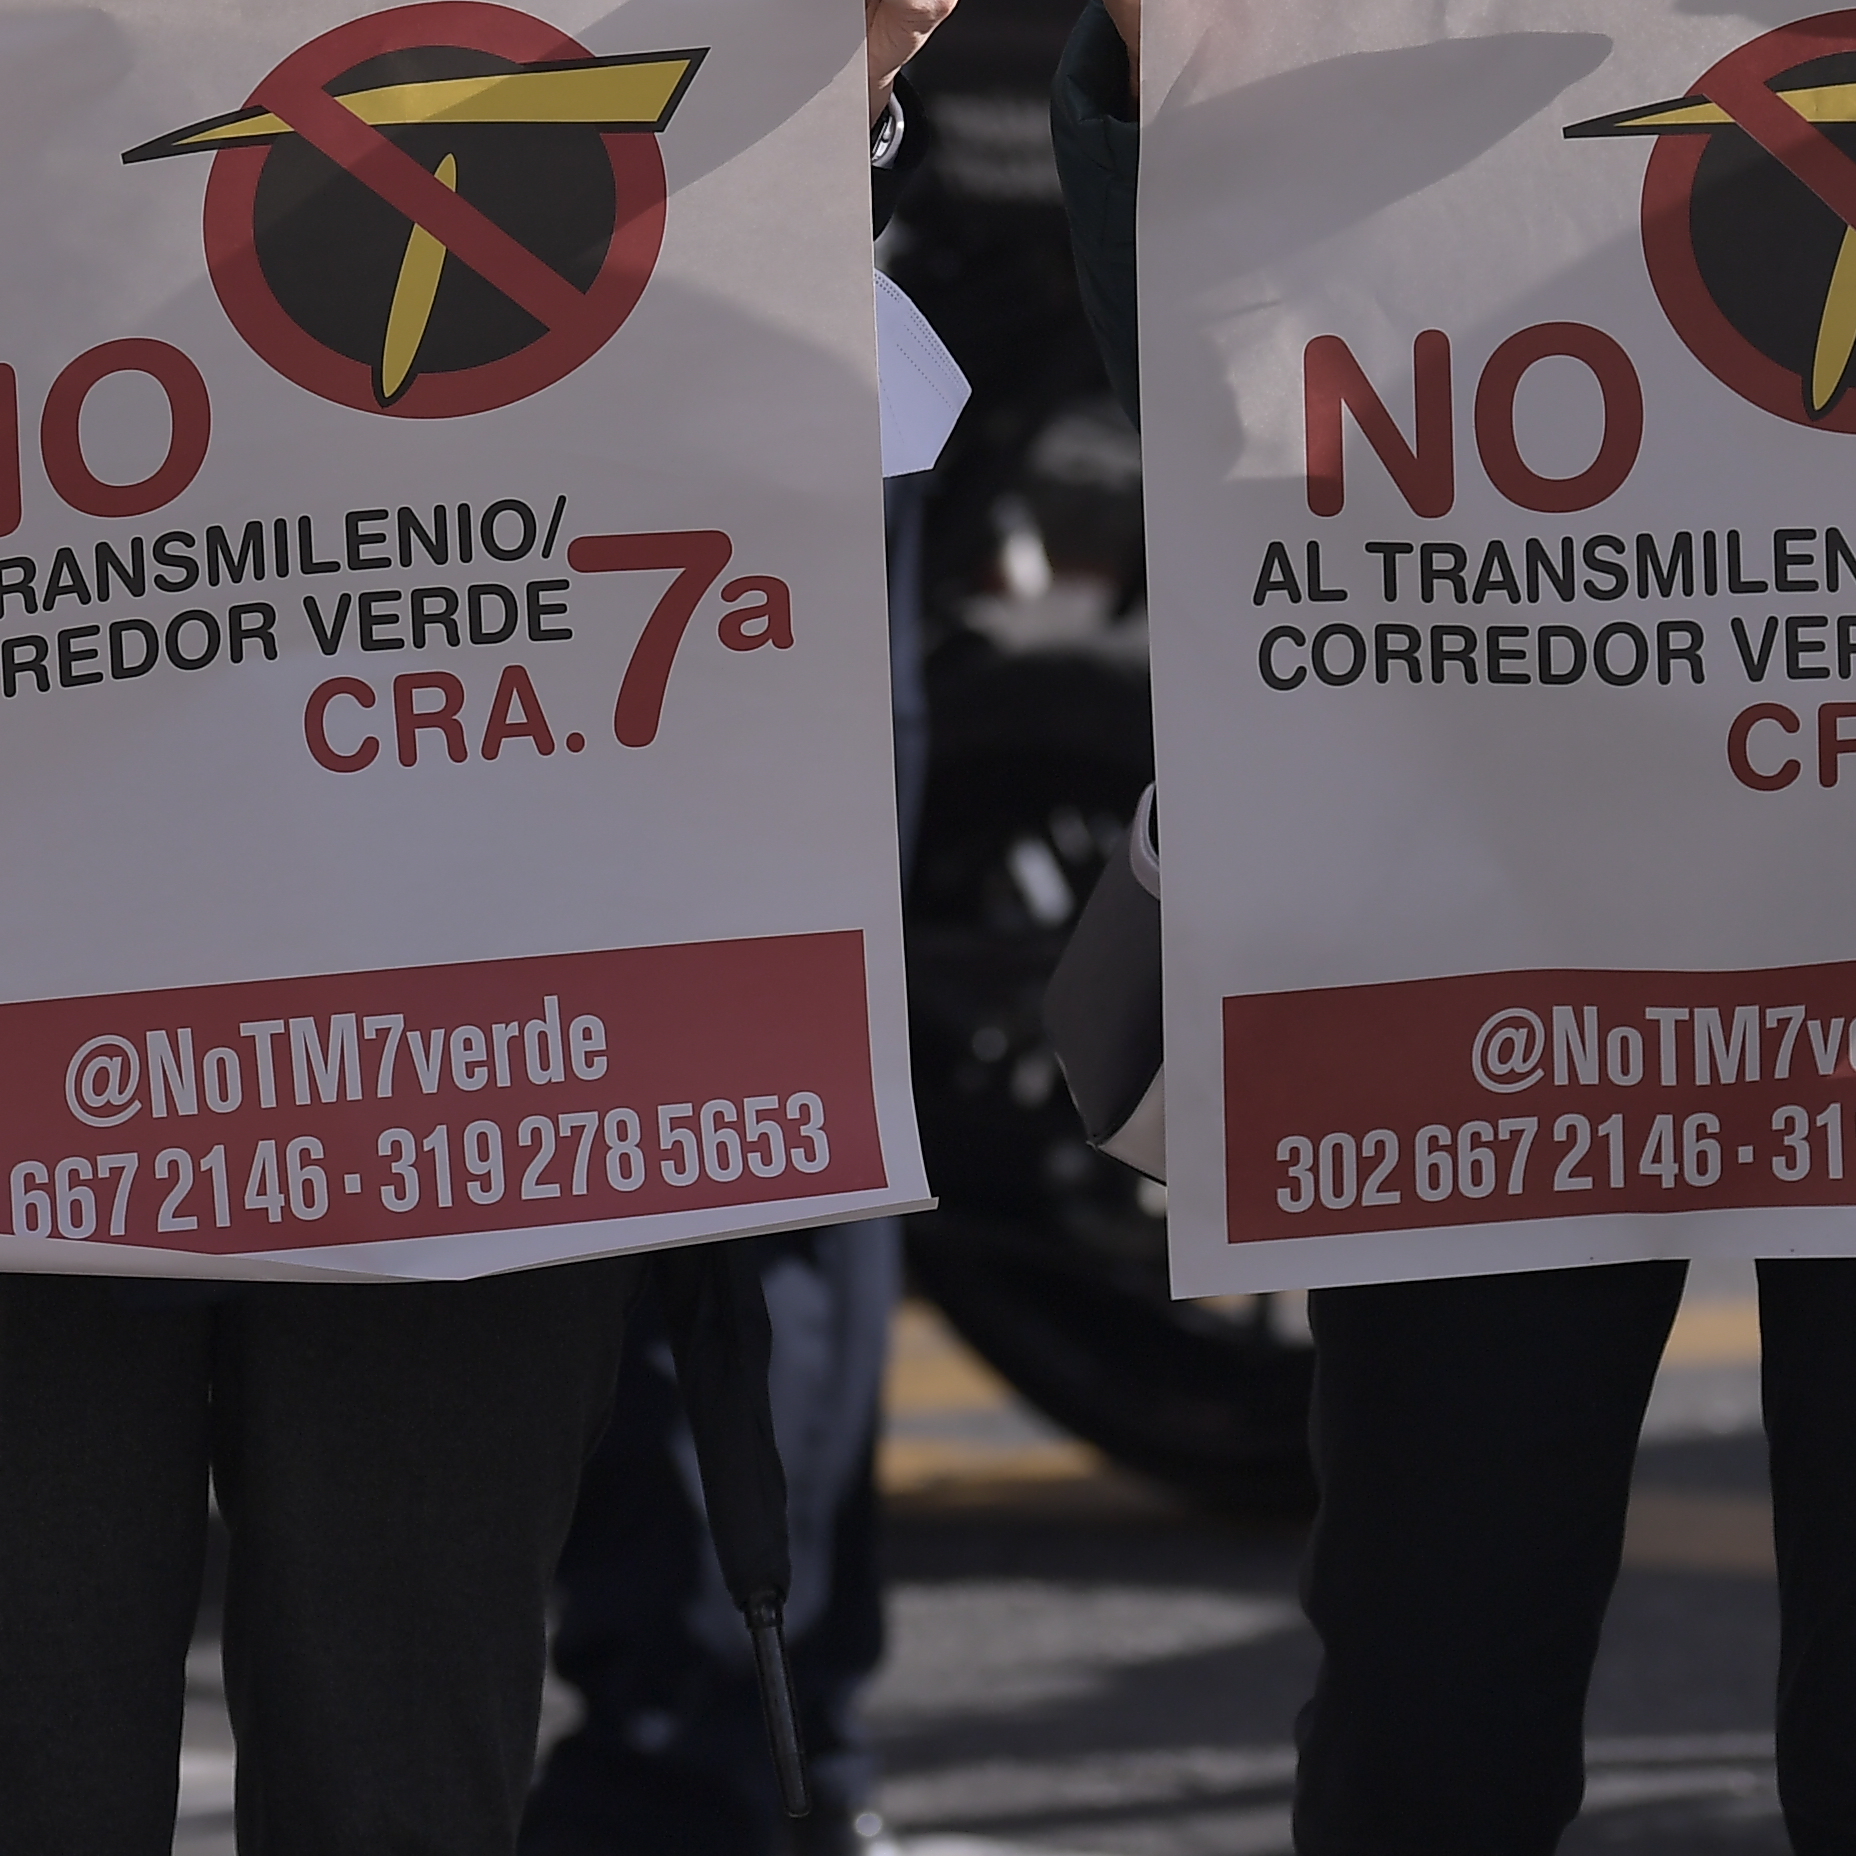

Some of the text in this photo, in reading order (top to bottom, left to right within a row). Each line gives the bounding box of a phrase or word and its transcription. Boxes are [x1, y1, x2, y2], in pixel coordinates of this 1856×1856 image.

[1303, 321, 1644, 519] NO
[302, 578, 574, 656] VERDE
[1252, 540, 1348, 607] AL
[1258, 614, 1706, 692] CORREDOR
[304, 664, 586, 773] CRA.
[64, 994, 609, 1129] @NoTM7verde
[9, 1150, 141, 1241] 667
[154, 1136, 330, 1234] 2146
[377, 1120, 505, 1213] 319
[518, 1107, 645, 1200] 278
[657, 1091, 830, 1187] 5653
[1275, 1129, 1401, 1213] 302
[1414, 1116, 1538, 1202] 667
[1553, 1112, 1722, 1192] 2146
